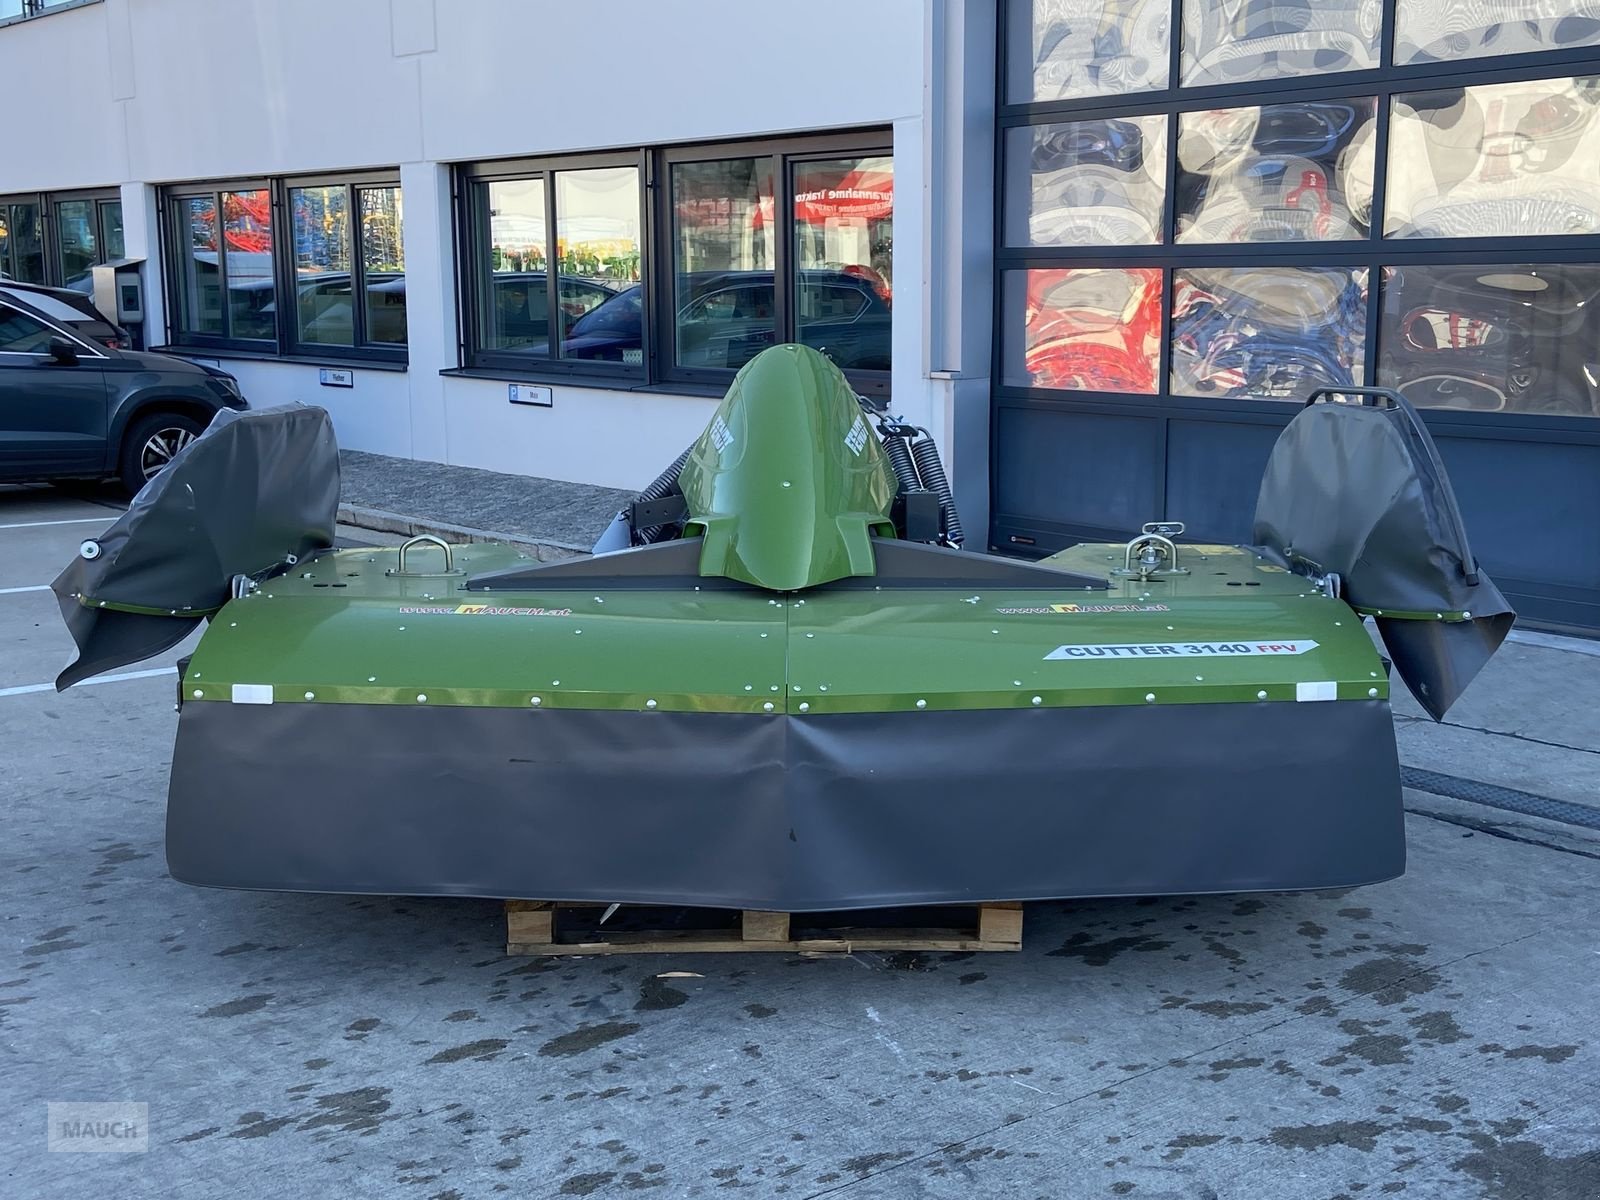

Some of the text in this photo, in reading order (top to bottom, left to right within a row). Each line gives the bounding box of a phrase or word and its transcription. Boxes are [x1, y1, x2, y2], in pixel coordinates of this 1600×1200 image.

[1065, 643, 1298, 657] CUTTER 3140 FPV
